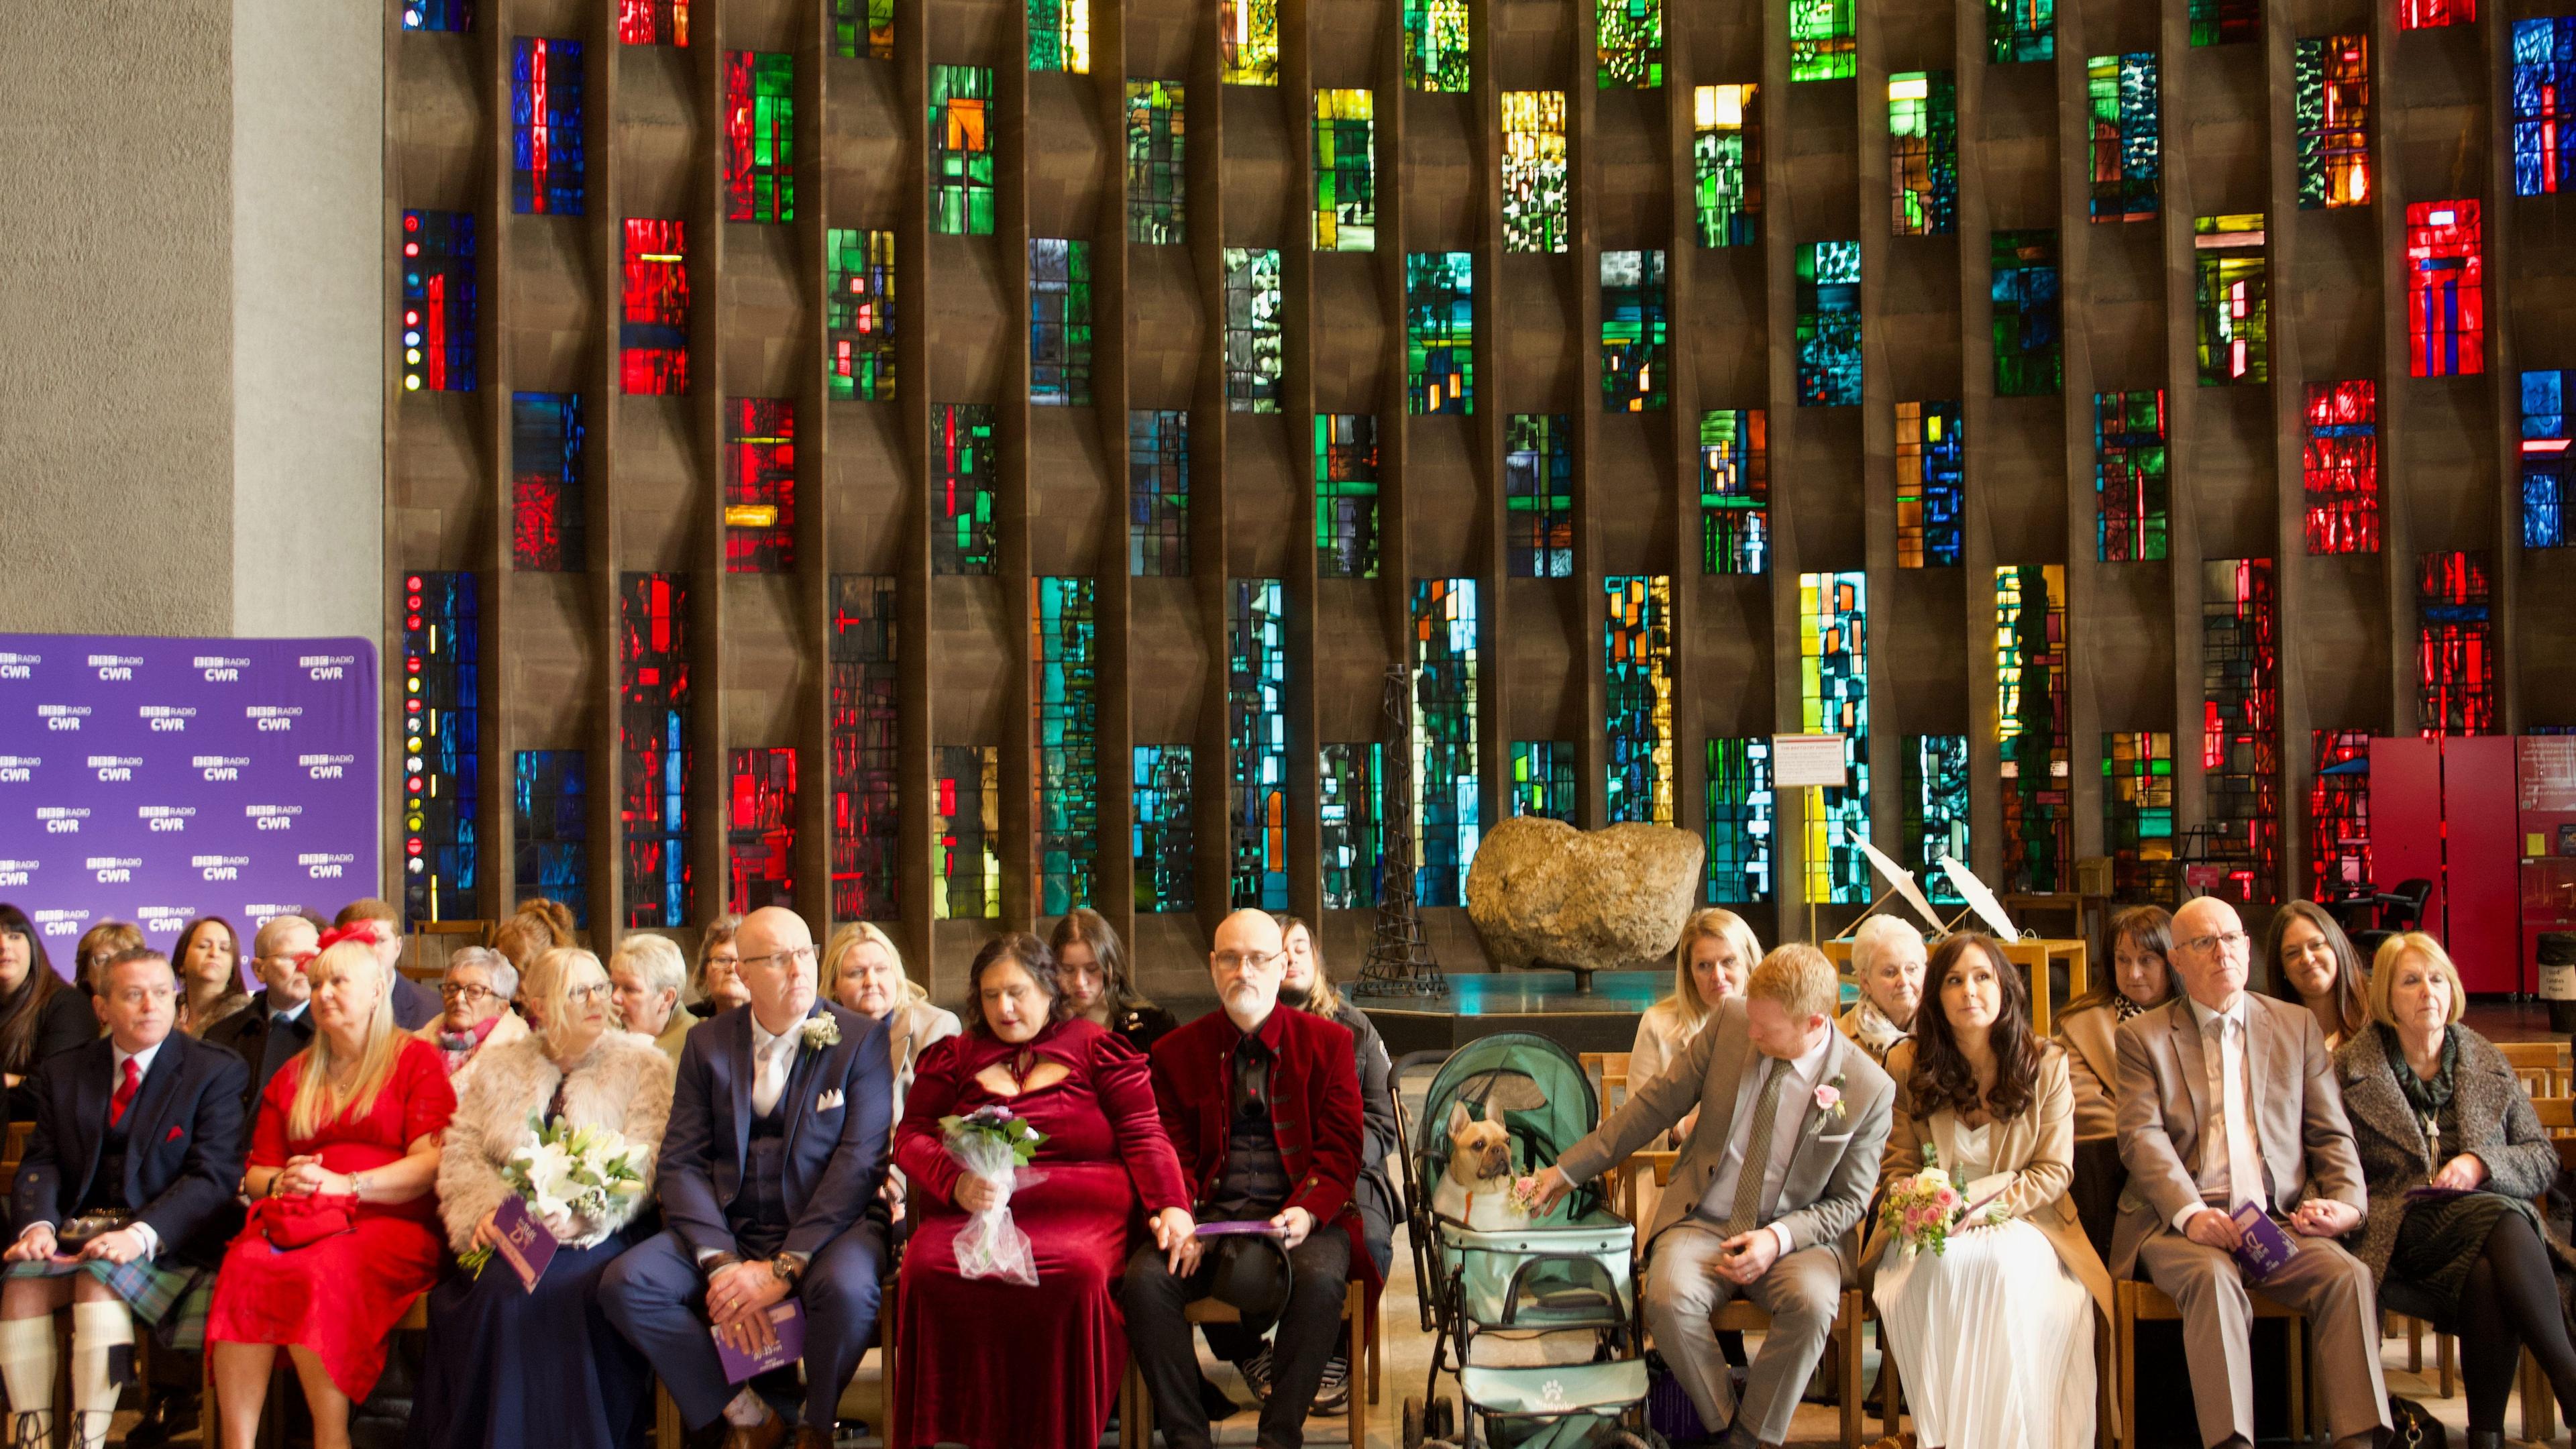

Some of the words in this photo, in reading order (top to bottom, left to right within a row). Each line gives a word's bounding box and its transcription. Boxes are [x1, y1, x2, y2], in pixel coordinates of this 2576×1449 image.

[17, 655, 41, 665] RADIO
[88, 655, 117, 667] BBC
[118, 657, 144, 667] RADIO
[194, 657, 224, 668] BBC
[225, 658, 250, 668] RADIO
[300, 655, 329, 667] BBC
[329, 656, 354, 666] RADIO
[0, 665, 30, 678] CWR
[99, 667, 132, 680] CWR
[205, 669, 238, 681] CWR
[311, 667, 343, 680] CWR
[38, 705, 66, 716] BBC
[67, 706, 91, 716] RADIO
[140, 706, 170, 717] BBC
[170, 708, 197, 718] RADIO
[246, 706, 276, 717] BBC
[277, 707, 303, 717] RADIO
[49, 717, 80, 730] CWR
[151, 718, 184, 731] CWR
[258, 718, 290, 731] CWR
[18, 757, 41, 767] RADIO
[87, 756, 117, 767] BBC
[118, 757, 143, 767] RADIO
[193, 756, 223, 767] BBC
[224, 757, 250, 767] RADIO
[299, 754, 329, 765] BBC
[329, 755, 354, 765] RADIO
[1, 769, 30, 782] CWR
[99, 768, 131, 781] CWR
[205, 768, 237, 780] CWR
[311, 766, 343, 778] CWR
[37, 807, 65, 818] BBC
[66, 808, 91, 818] RADIO
[139, 806, 169, 817] BBC
[170, 807, 196, 817] RADIO
[246, 805, 276, 816] BBC
[276, 806, 302, 816] RADIO
[47, 819, 78, 833] CWR
[150, 818, 184, 830] CWR
[258, 817, 290, 829] CWR
[87, 857, 116, 869] BBC
[117, 858, 142, 868] RADIO
[192, 855, 223, 867] BBC
[223, 856, 249, 866] RADIO
[299, 853, 328, 865] BBC
[329, 853, 354, 863] RADIO
[15, 861, 39, 871] RADIO
[310, 865, 342, 877] CWR
[0, 872, 28, 885] CWR
[98, 869, 130, 882] CWR
[204, 867, 237, 880] CWR
[35, 910, 64, 921] BBC
[64, 910, 89, 920] RADIO
[138, 906, 168, 918] BBC
[169, 907, 195, 917] RADIO
[246, 904, 276, 916] BBC
[277, 905, 301, 913] RADIO
[46, 922, 77, 934] CWR
[150, 918, 183, 931] CWR
